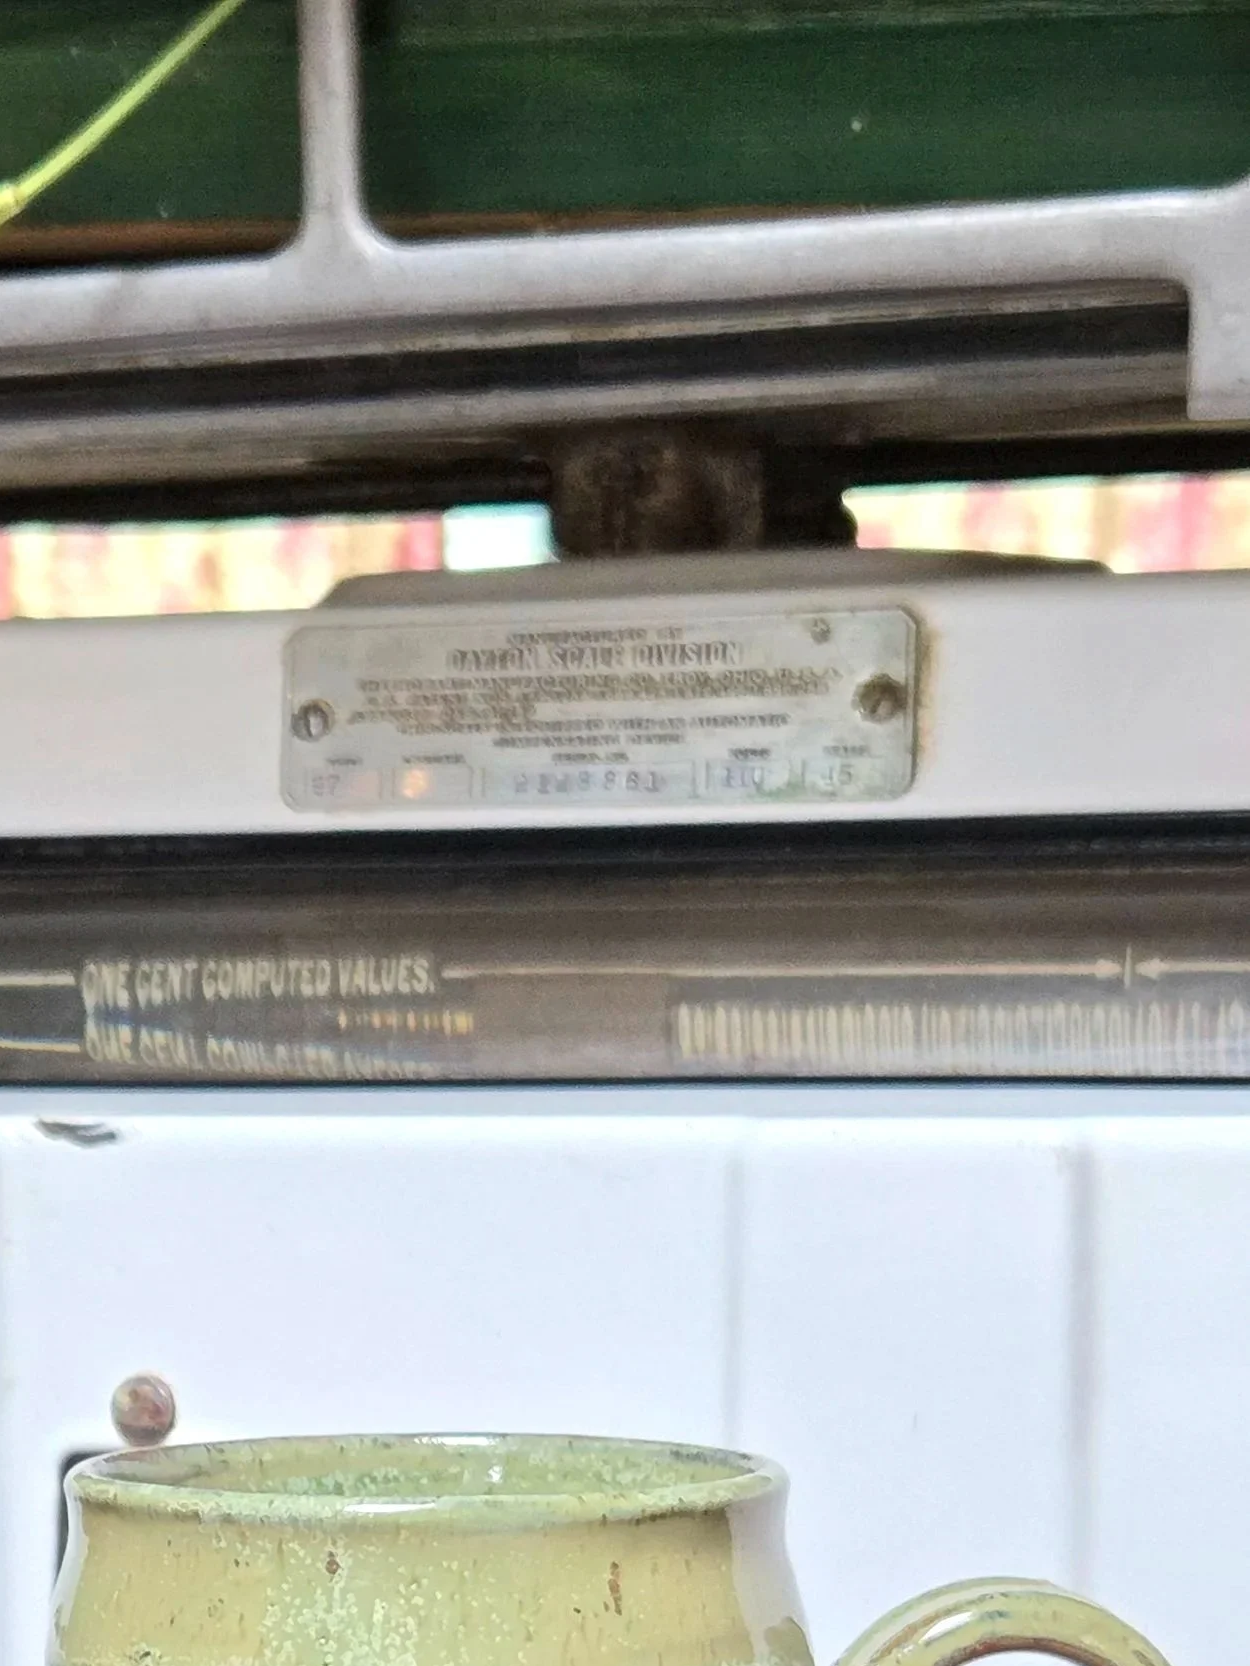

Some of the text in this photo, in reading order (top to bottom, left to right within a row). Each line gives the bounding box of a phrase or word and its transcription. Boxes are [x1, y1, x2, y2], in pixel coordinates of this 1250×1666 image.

[550, 644, 624, 670] SCALE
[634, 641, 743, 667] DIVISION
[81, 959, 131, 1006] ONE
[202, 957, 332, 999] COMPUTED
